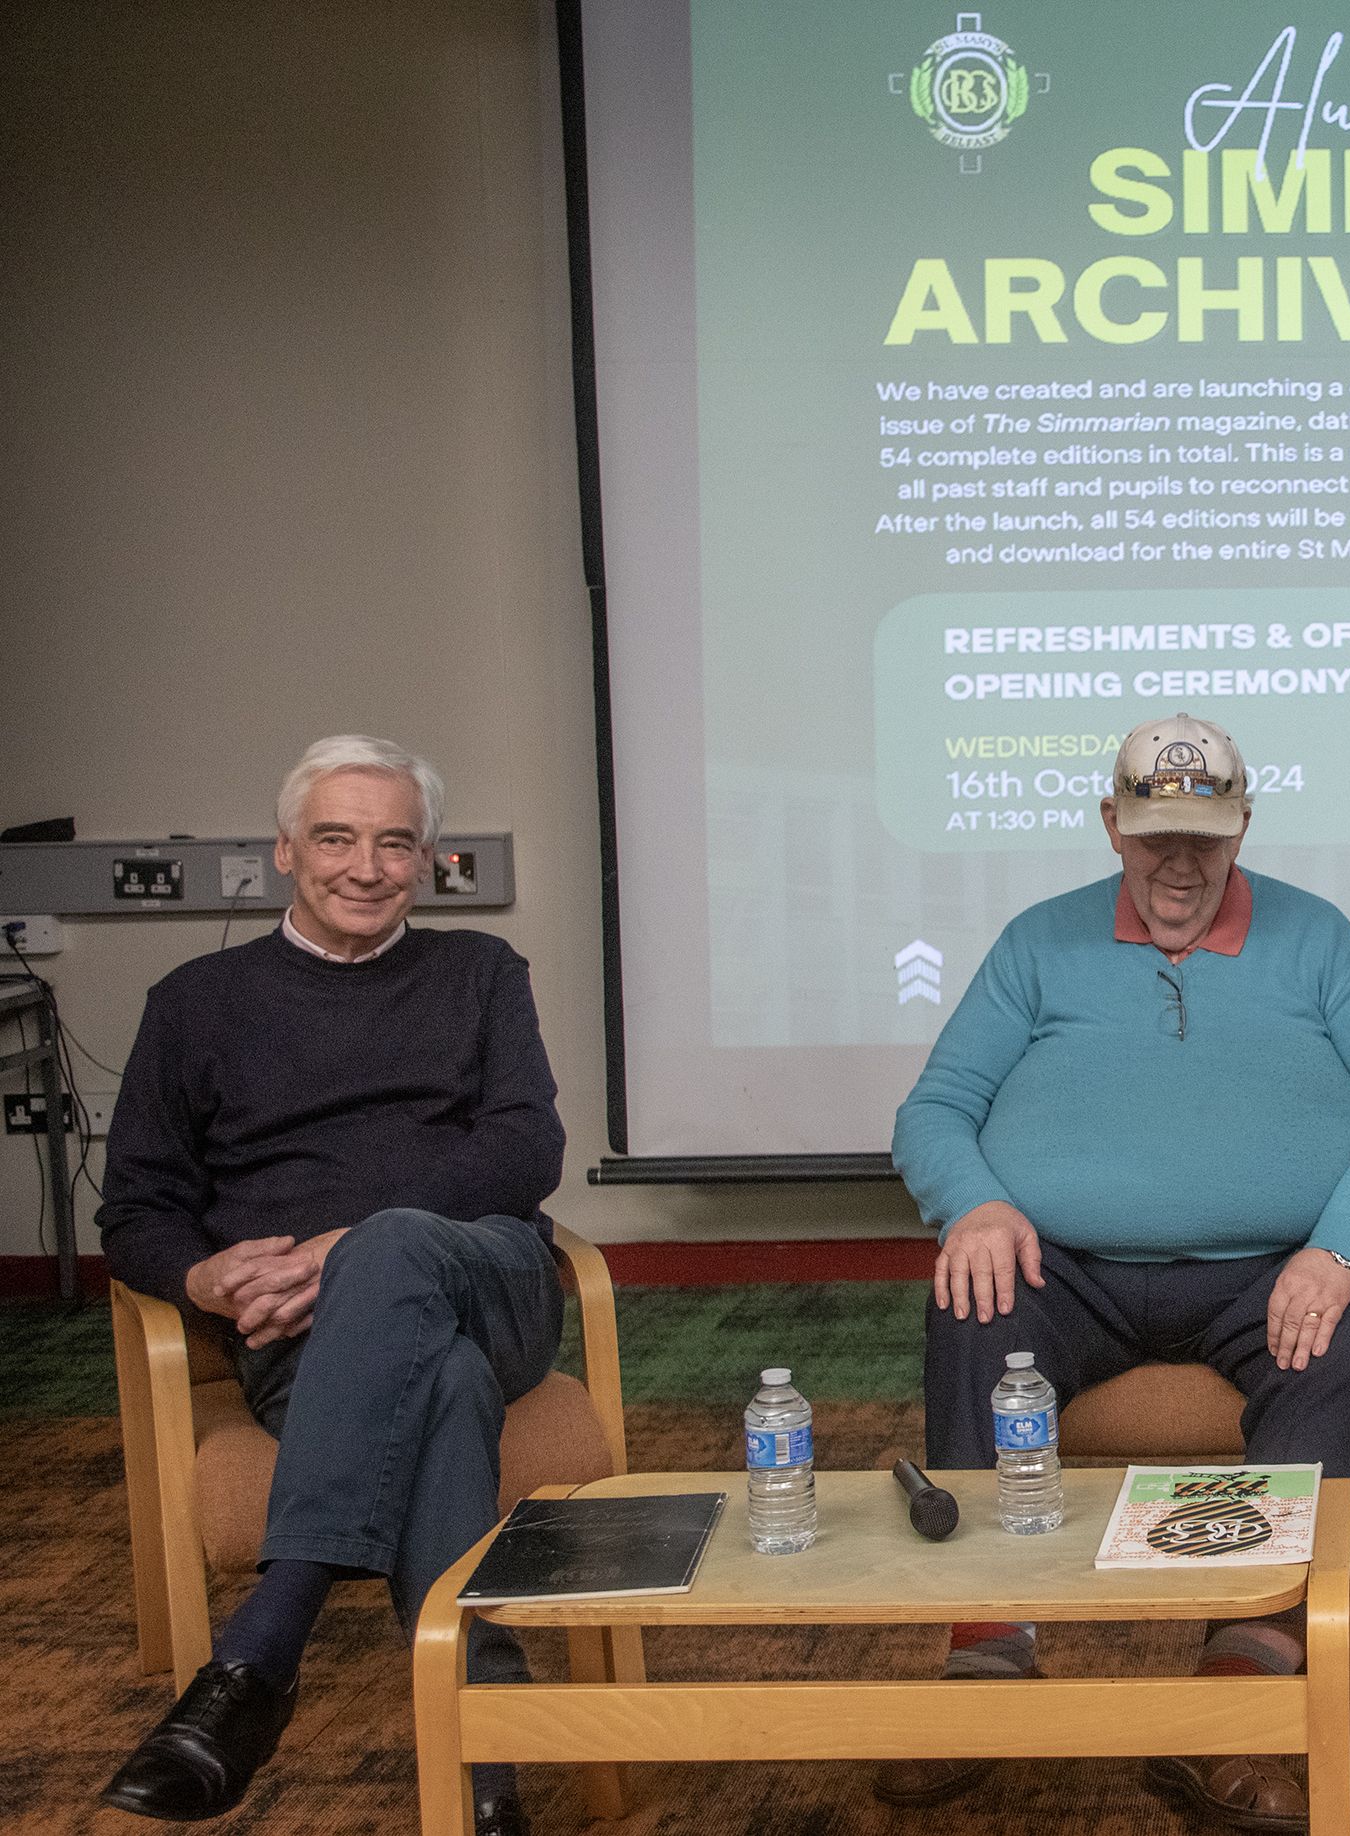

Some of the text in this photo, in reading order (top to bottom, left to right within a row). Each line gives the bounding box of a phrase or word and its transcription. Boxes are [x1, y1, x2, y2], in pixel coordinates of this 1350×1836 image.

[876, 382, 922, 401] We
[927, 381, 989, 400] have
[995, 380, 1093, 400] created
[1099, 379, 1146, 399] and
[1152, 384, 1193, 398] are
[1199, 378, 1322, 401] launching
[1328, 382, 1343, 396] a
[880, 416, 944, 435] issue
[950, 415, 976, 434] of
[983, 414, 1031, 433] The
[1037, 412, 1171, 432] Simmarian
[1177, 412, 1302, 437] magazine,
[880, 448, 912, 468] 54
[917, 447, 1037, 469] complete
[1043, 445, 1143, 466] editions
[1149, 445, 1171, 463] in
[1178, 444, 1239, 464] total.
[1245, 443, 1298, 462] This
[1304, 443, 1323, 461] is
[1328, 447, 1344, 461] a
[898, 479, 925, 500] all
[932, 480, 987, 502] past
[992, 478, 1048, 498] staff
[1055, 477, 1101, 497] and
[1109, 476, 1183, 499] pupils
[1188, 477, 1215, 495] to
[1221, 475, 1349, 495] reconnect
[875, 513, 939, 533] After
[944, 512, 986, 531] the
[993, 510, 1084, 532] launch,
[1090, 509, 1118, 529] all
[1125, 509, 1155, 529] 54
[1162, 508, 1260, 528] editions
[1266, 508, 1308, 527] will
[1315, 508, 1345, 526] be
[946, 544, 993, 563] and
[999, 543, 1125, 562] download
[1131, 542, 1165, 560] for
[1171, 541, 1214, 560] the
[1218, 540, 1291, 560] entire
[1297, 540, 1324, 558] St
[944, 624, 1256, 653] REFRESHMENTS
[1266, 624, 1293, 649] &
[944, 672, 1122, 700] OPENING
[945, 734, 1127, 759] WEDNESDA
[946, 768, 1024, 799] 16th
[1245, 764, 1305, 794] 024
[945, 809, 1085, 831] AT 1:30 PM
